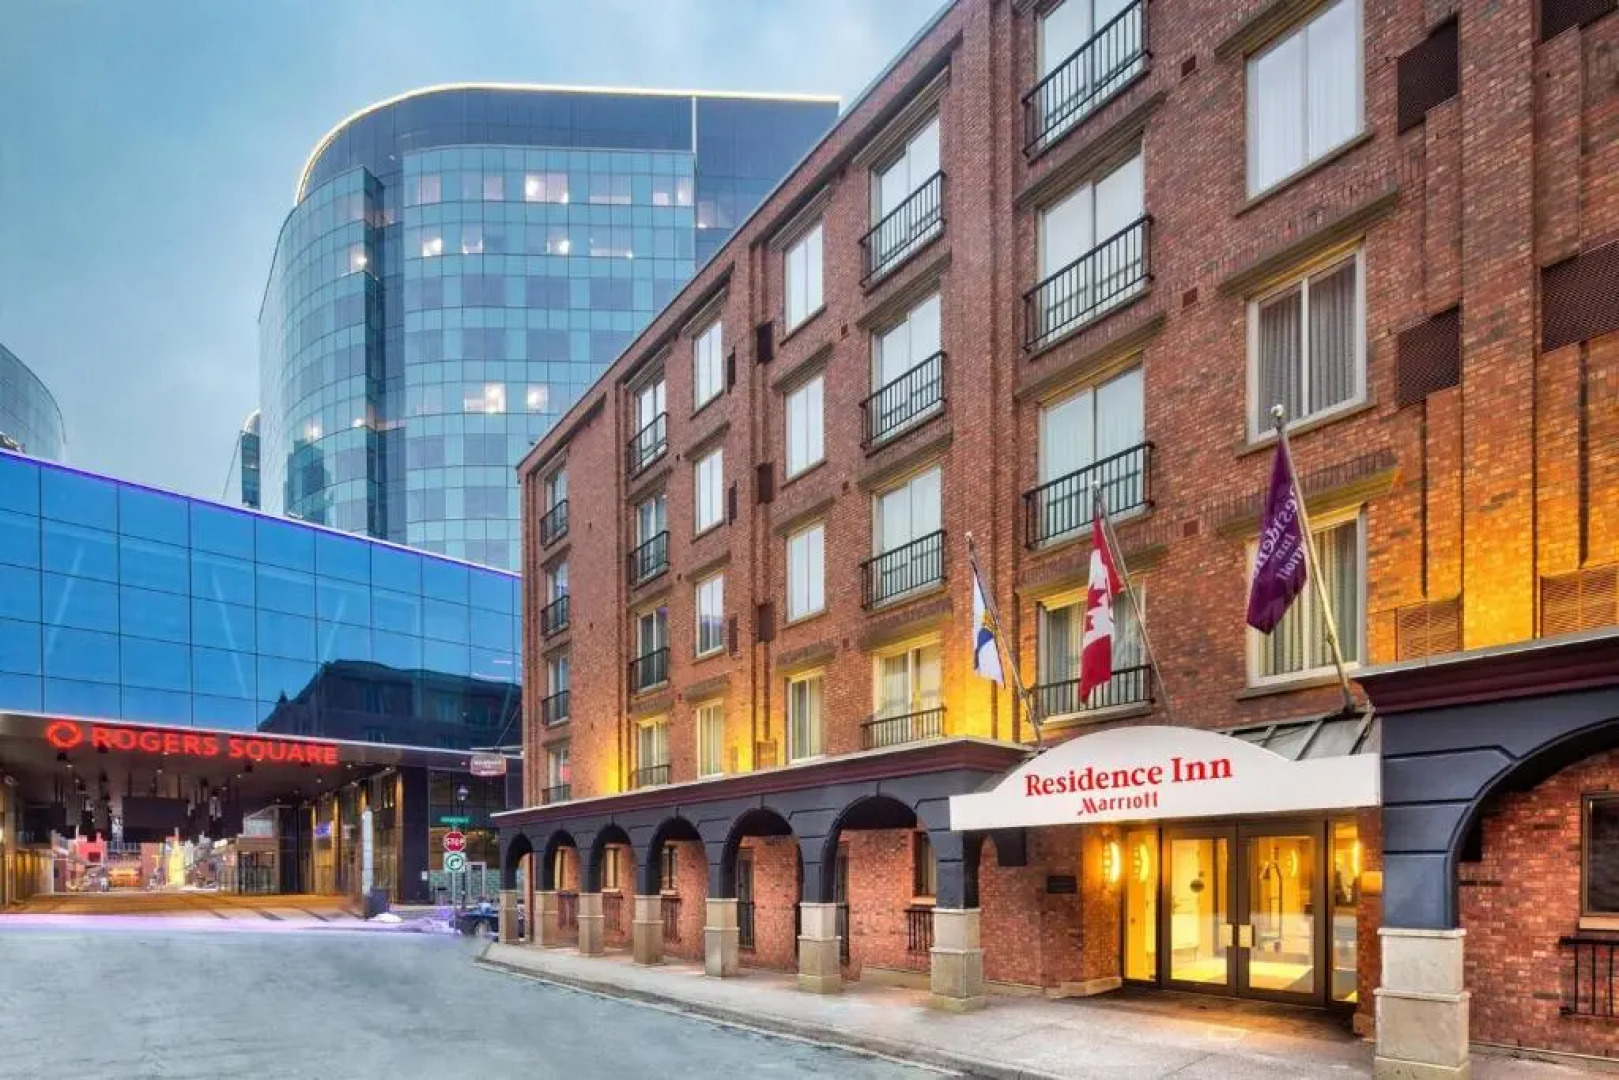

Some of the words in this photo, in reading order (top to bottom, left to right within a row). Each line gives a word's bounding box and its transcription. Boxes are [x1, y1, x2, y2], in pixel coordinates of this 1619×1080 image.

[91, 726, 219, 757] ROGERS
[228, 737, 339, 765] SQUARE
[1025, 766, 1164, 797] Residence
[1170, 757, 1233, 784] Inn
[1077, 791, 1159, 817] Marriott
[445, 837, 464, 847] STOP
